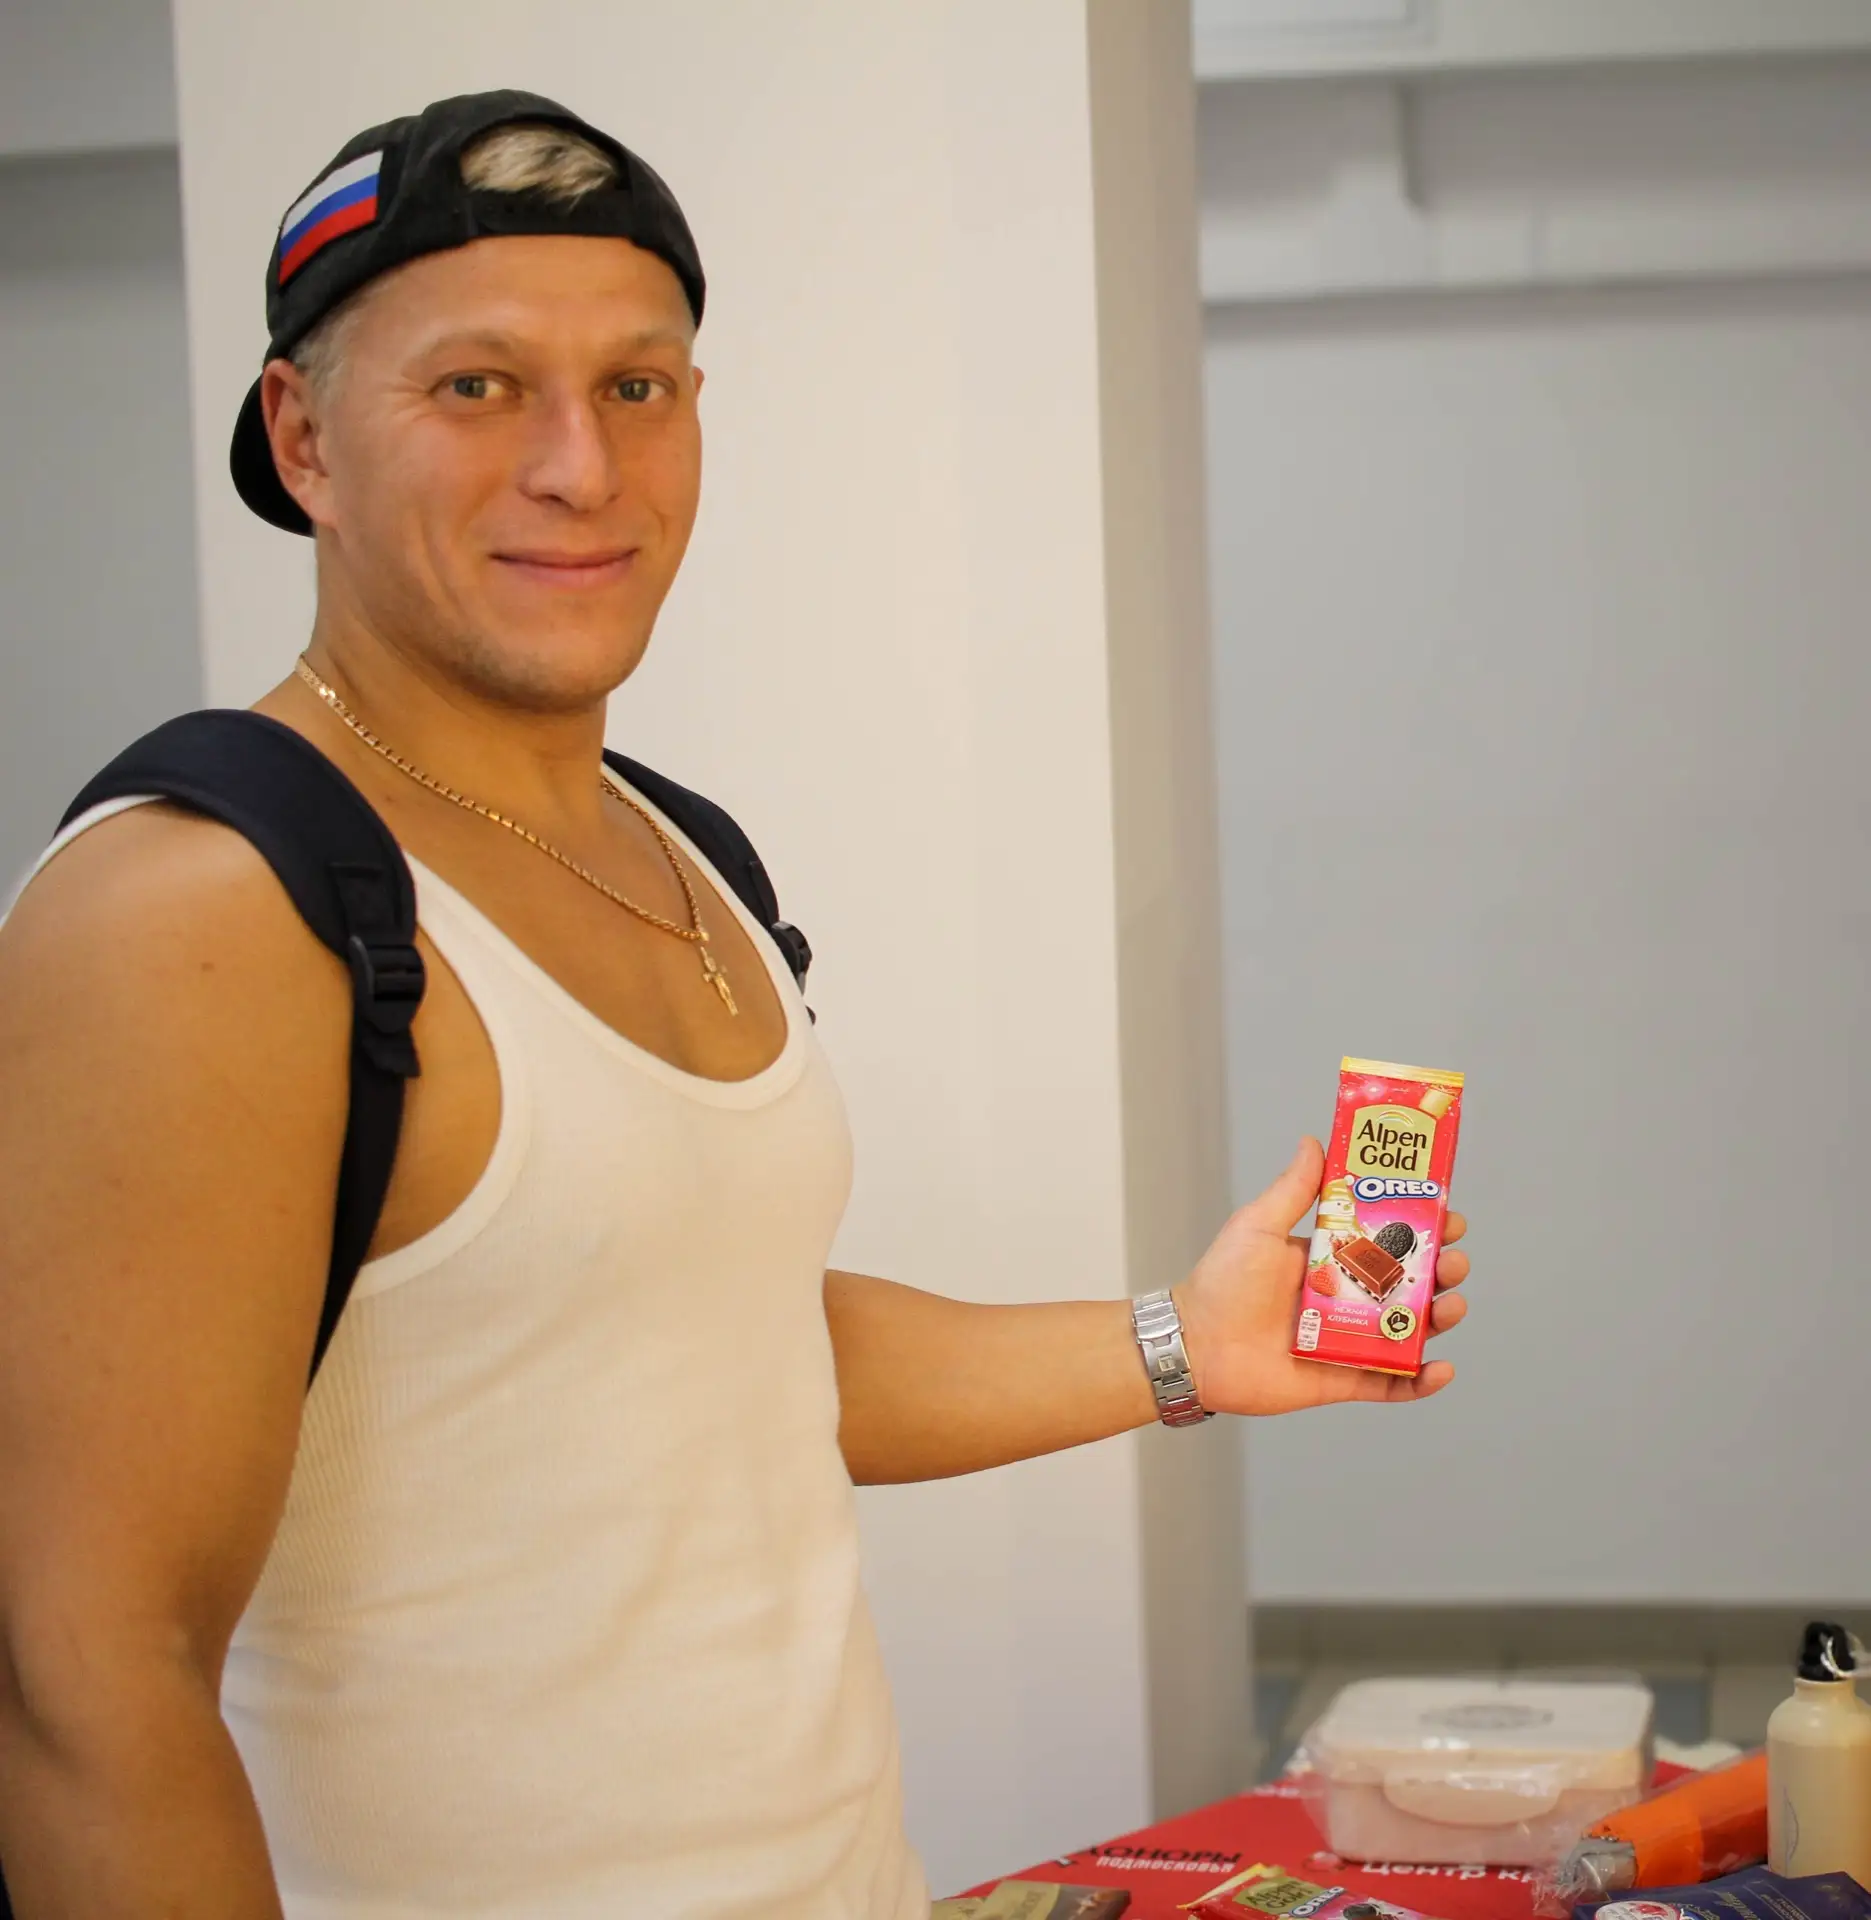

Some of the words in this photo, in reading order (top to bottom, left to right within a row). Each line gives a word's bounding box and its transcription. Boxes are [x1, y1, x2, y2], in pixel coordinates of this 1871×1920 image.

[1357, 1119, 1427, 1150] Alpen
[1359, 1145, 1418, 1171] Gold
[1354, 1177, 1441, 1202] OREO
[1327, 1315, 1369, 1326] КЛУБНИКА
